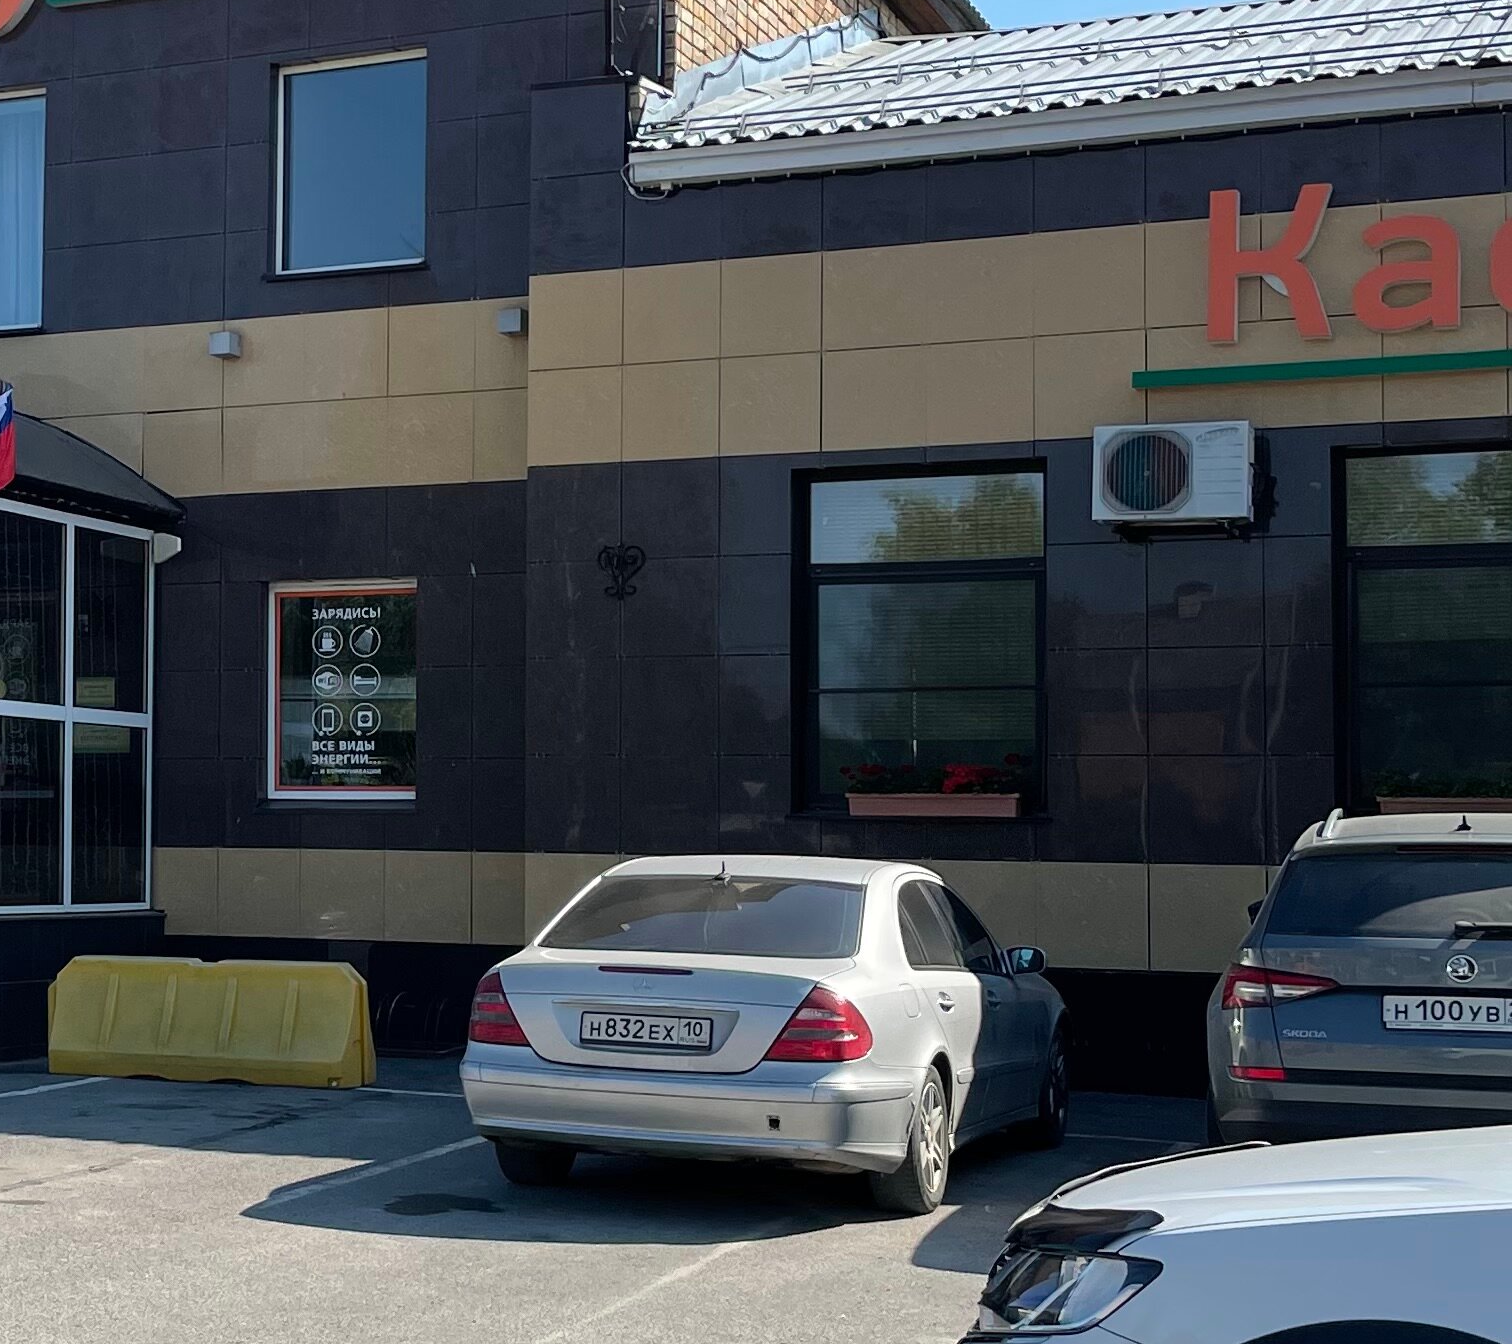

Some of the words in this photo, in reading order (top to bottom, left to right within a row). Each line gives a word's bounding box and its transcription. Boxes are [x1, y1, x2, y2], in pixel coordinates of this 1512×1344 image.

[1207, 182, 1512, 344] Ка
[311, 740, 335, 752] ВСЕ
[338, 740, 375, 752] ВИДЫ
[682, 1020, 703, 1037] 10
